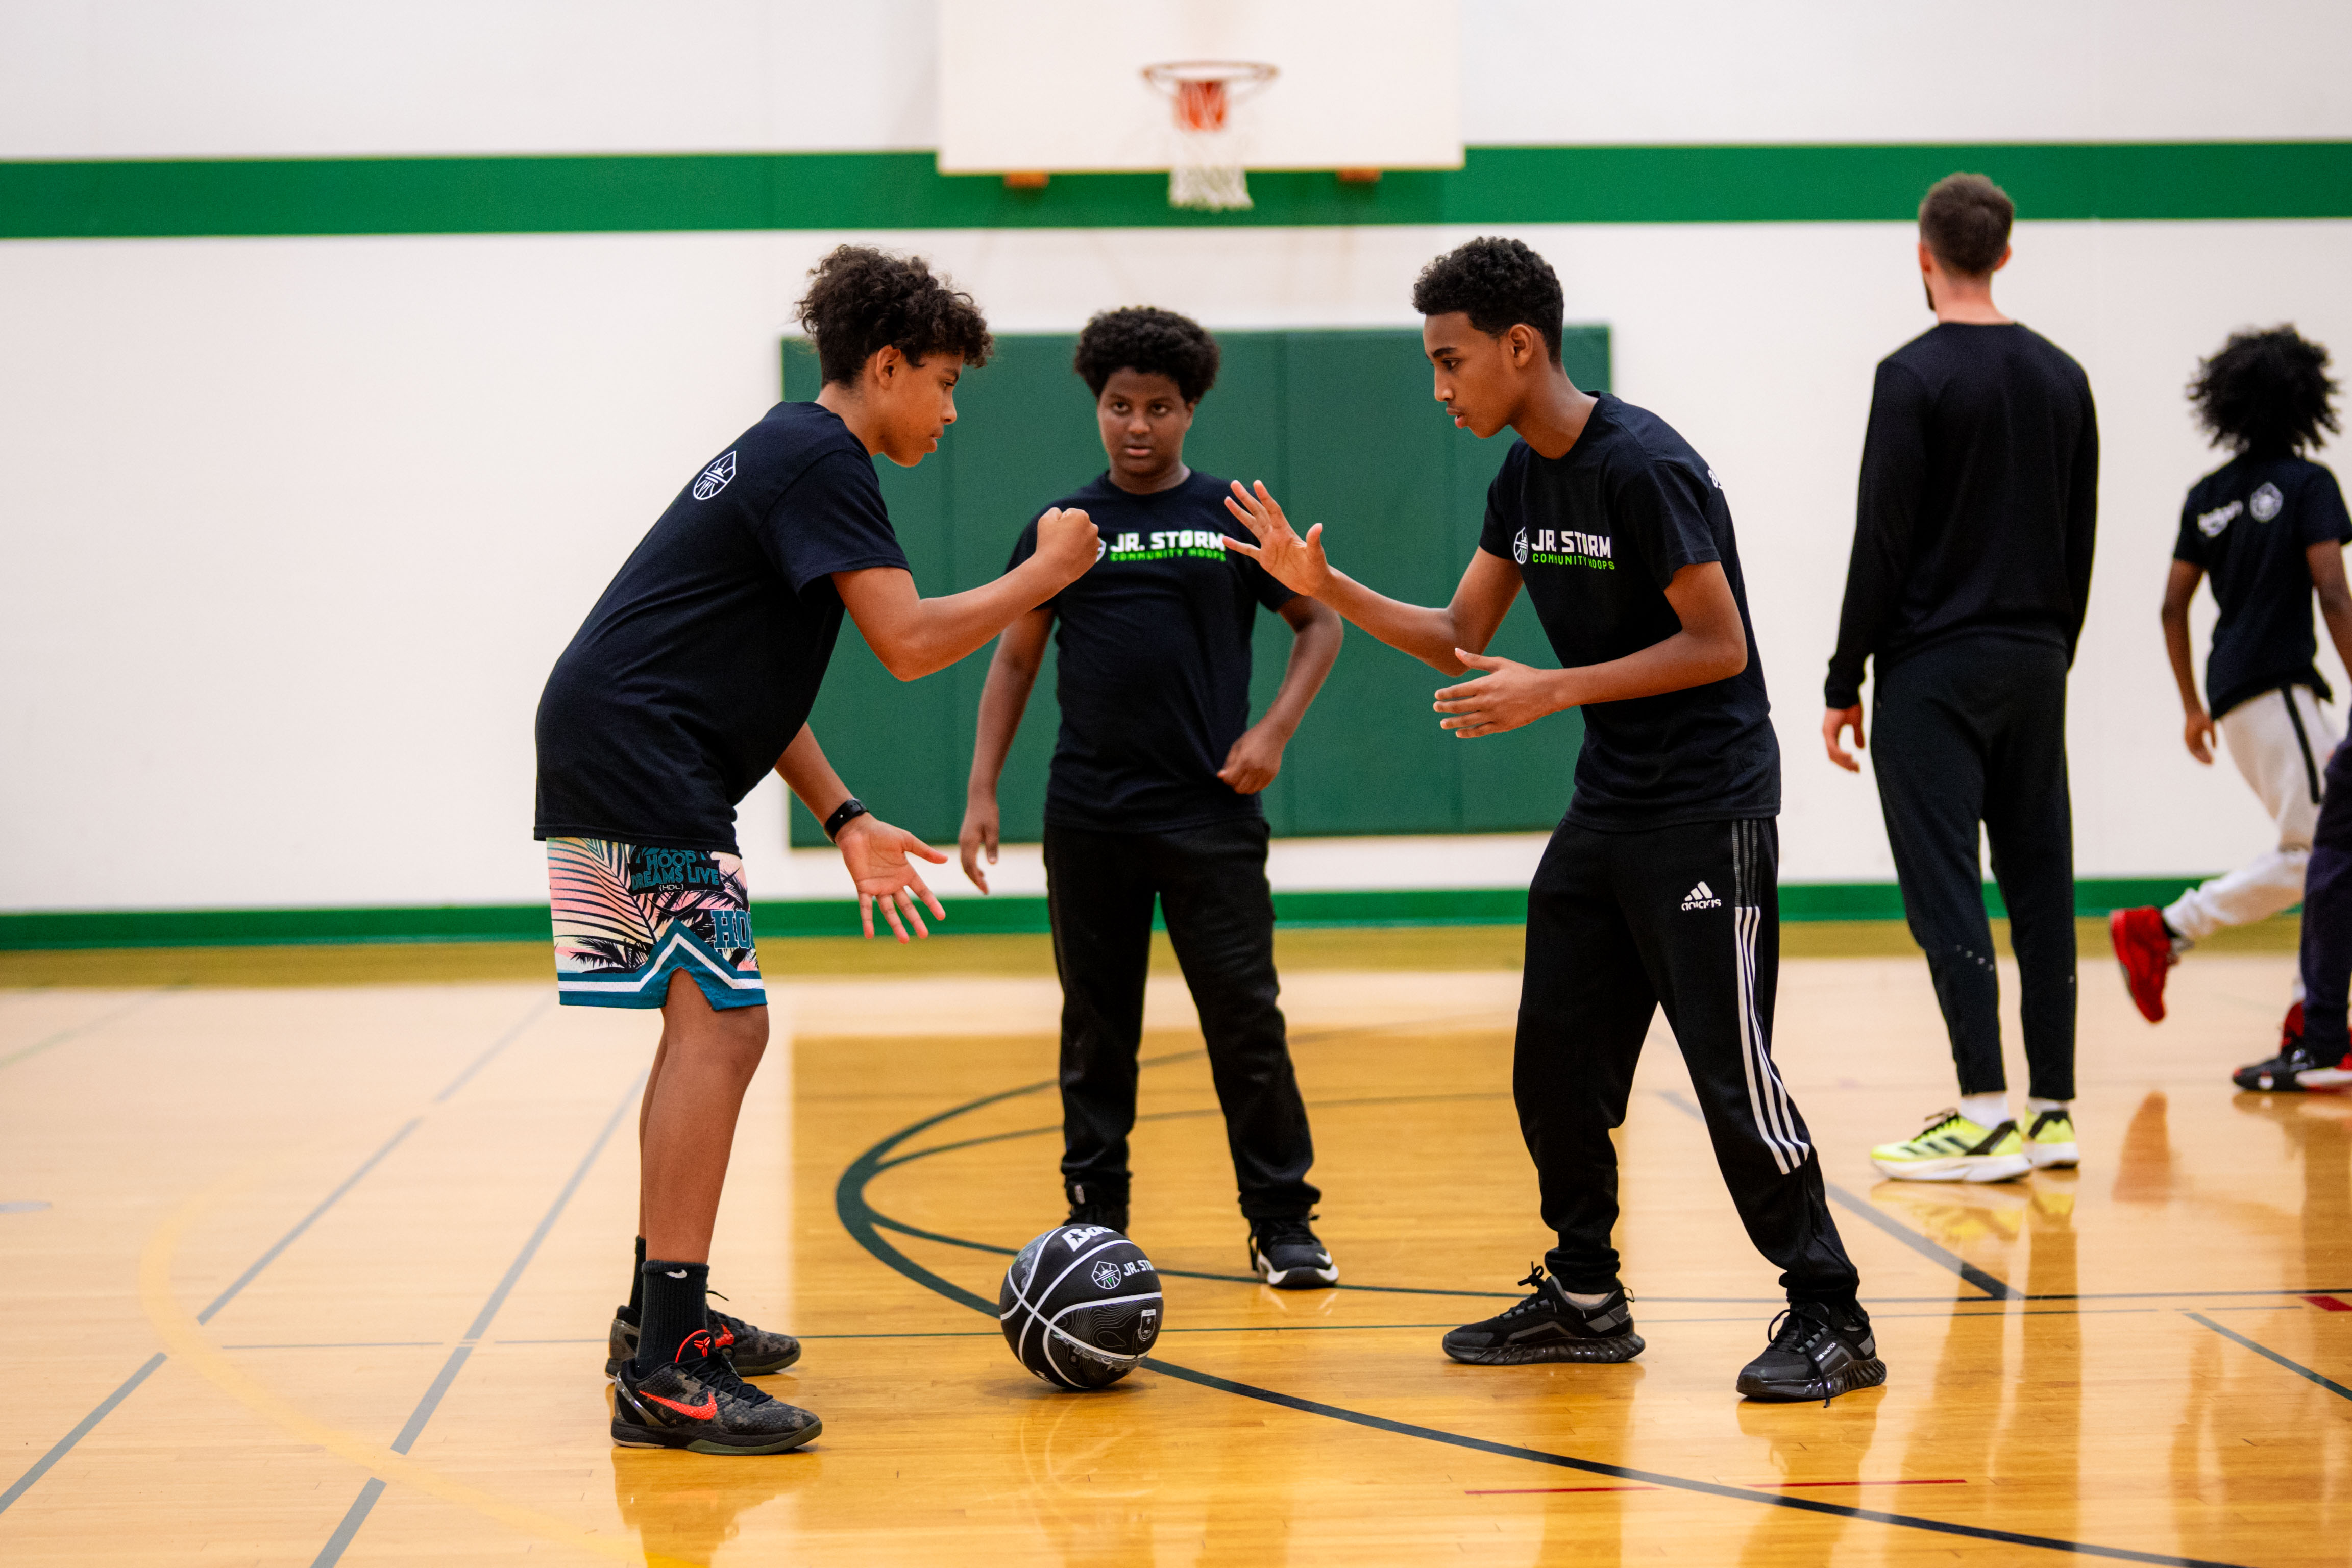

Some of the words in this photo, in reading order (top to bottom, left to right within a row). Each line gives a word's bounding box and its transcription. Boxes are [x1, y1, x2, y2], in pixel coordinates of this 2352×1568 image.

[1110, 532, 1145, 552] JR.
[1150, 529, 1226, 552] STORM
[1531, 529, 1557, 552] JR.
[1561, 531, 1611, 558] STORM
[1110, 548, 1184, 561] COMMUNITY
[1188, 548, 1226, 561] HOOPS
[1532, 553, 1587, 566] COMMUNITY
[1588, 558, 1615, 570] HOOPS
[646, 852, 697, 870] HOOP
[631, 867, 684, 891] DREAMS
[687, 866, 719, 886] LIVE
[659, 884, 684, 892] (HDL)
[1123, 1262, 1140, 1276] JR.
